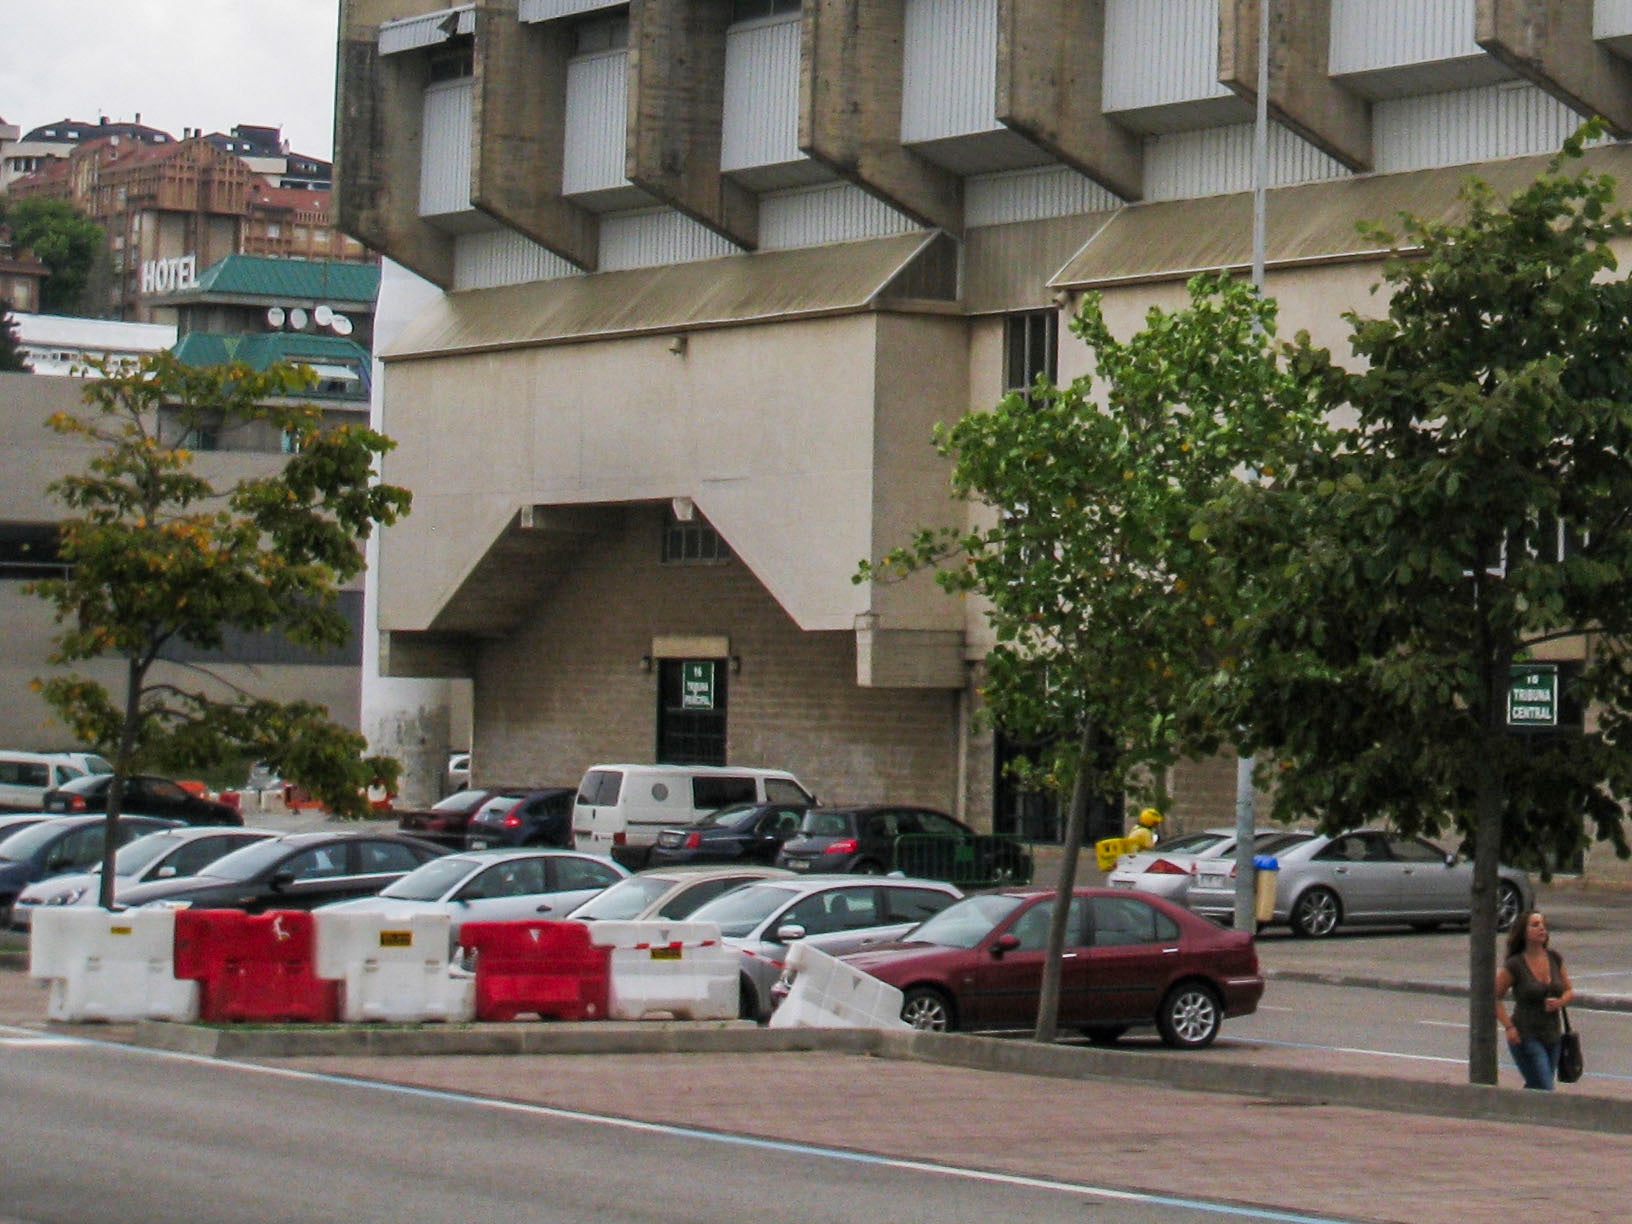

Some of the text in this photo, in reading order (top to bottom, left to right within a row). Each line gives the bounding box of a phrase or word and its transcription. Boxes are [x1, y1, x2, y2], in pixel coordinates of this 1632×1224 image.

[141, 254, 200, 293] HOTEL
[1512, 688, 1551, 702] TRIBUNA
[1512, 706, 1552, 720] CENTRAL
